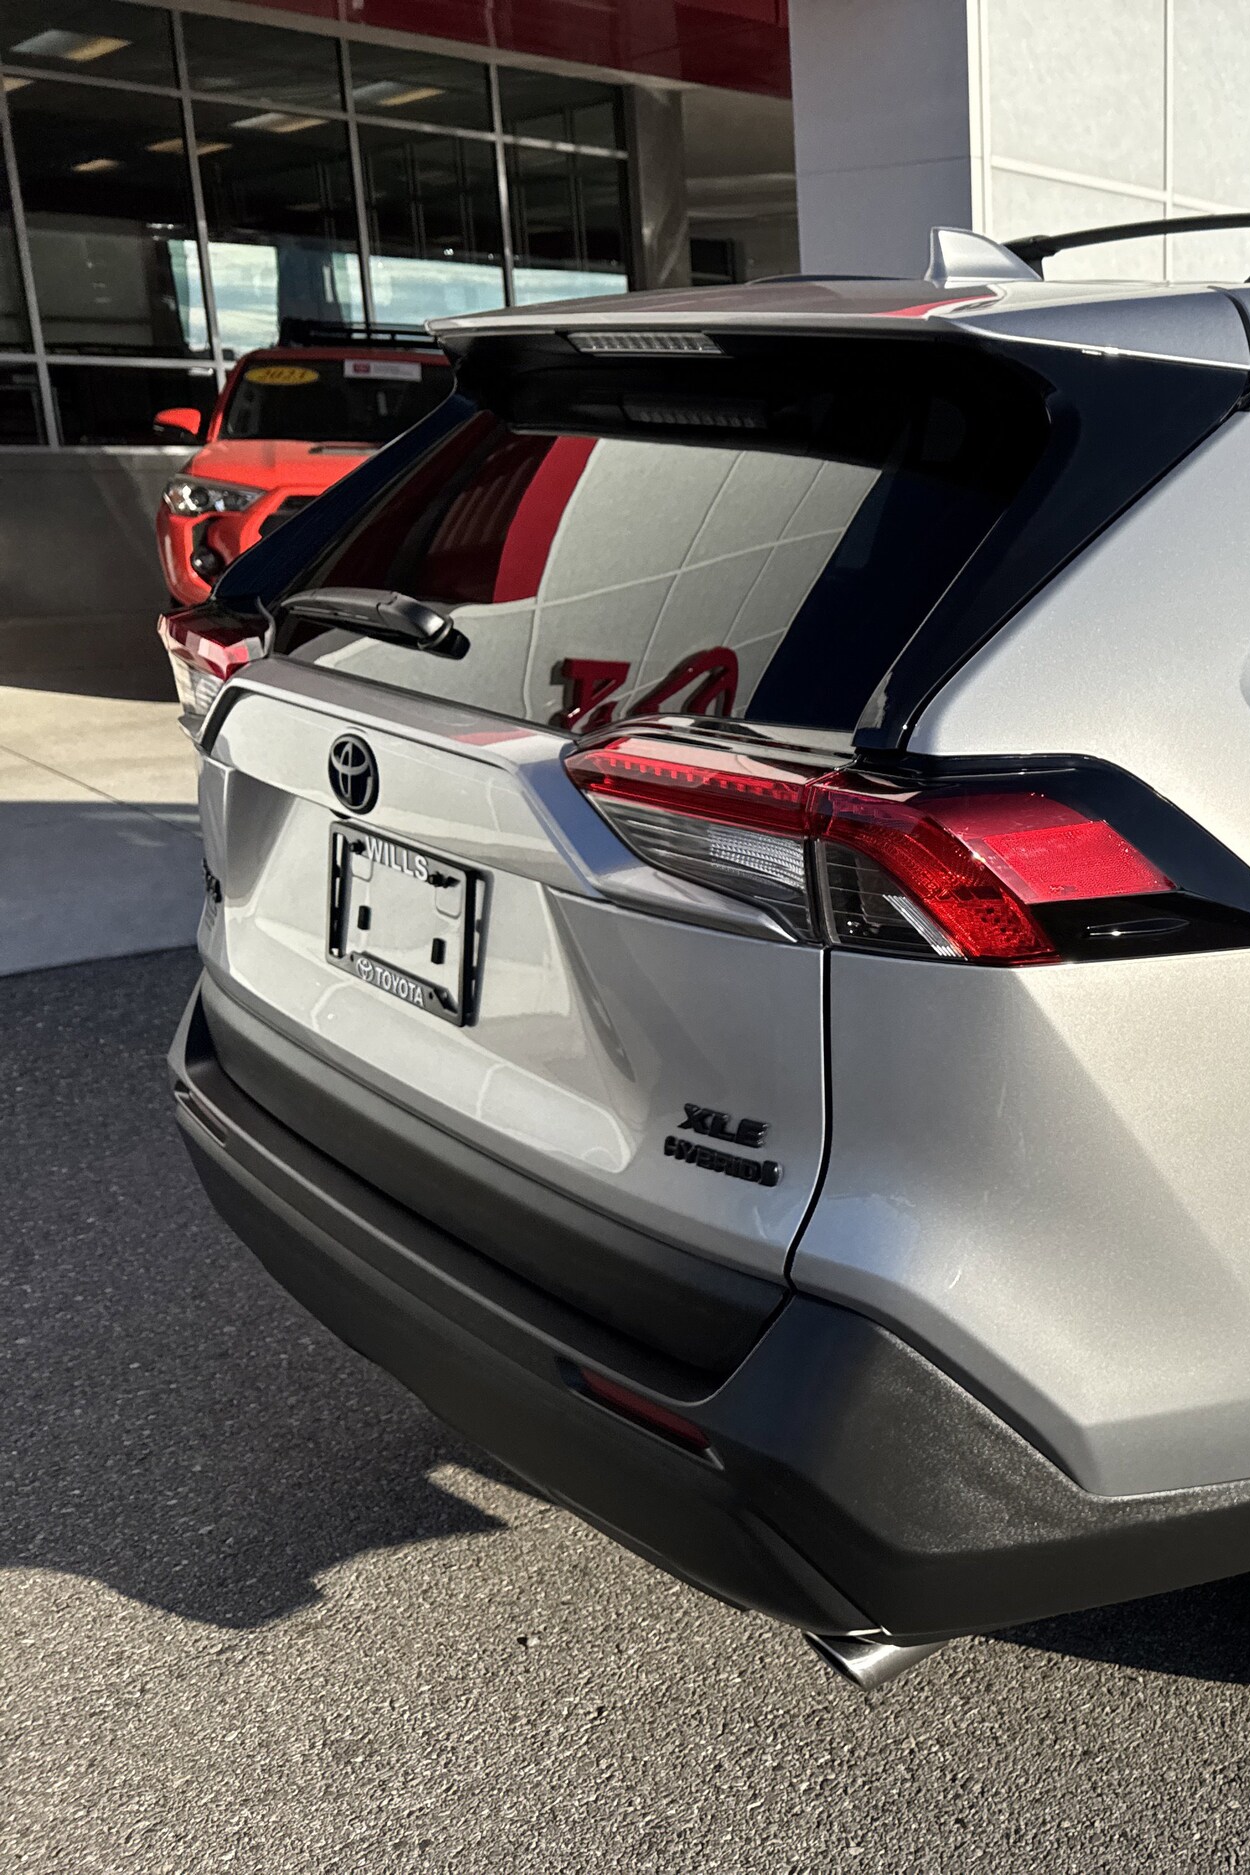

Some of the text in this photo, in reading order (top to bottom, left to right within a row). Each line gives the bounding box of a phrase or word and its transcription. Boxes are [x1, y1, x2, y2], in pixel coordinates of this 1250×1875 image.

[365, 836, 429, 881] WILLS
[374, 966, 425, 1006] TOYOTA
[677, 1103, 769, 1148] XLE
[664, 1135, 783, 1187] HYBRID
